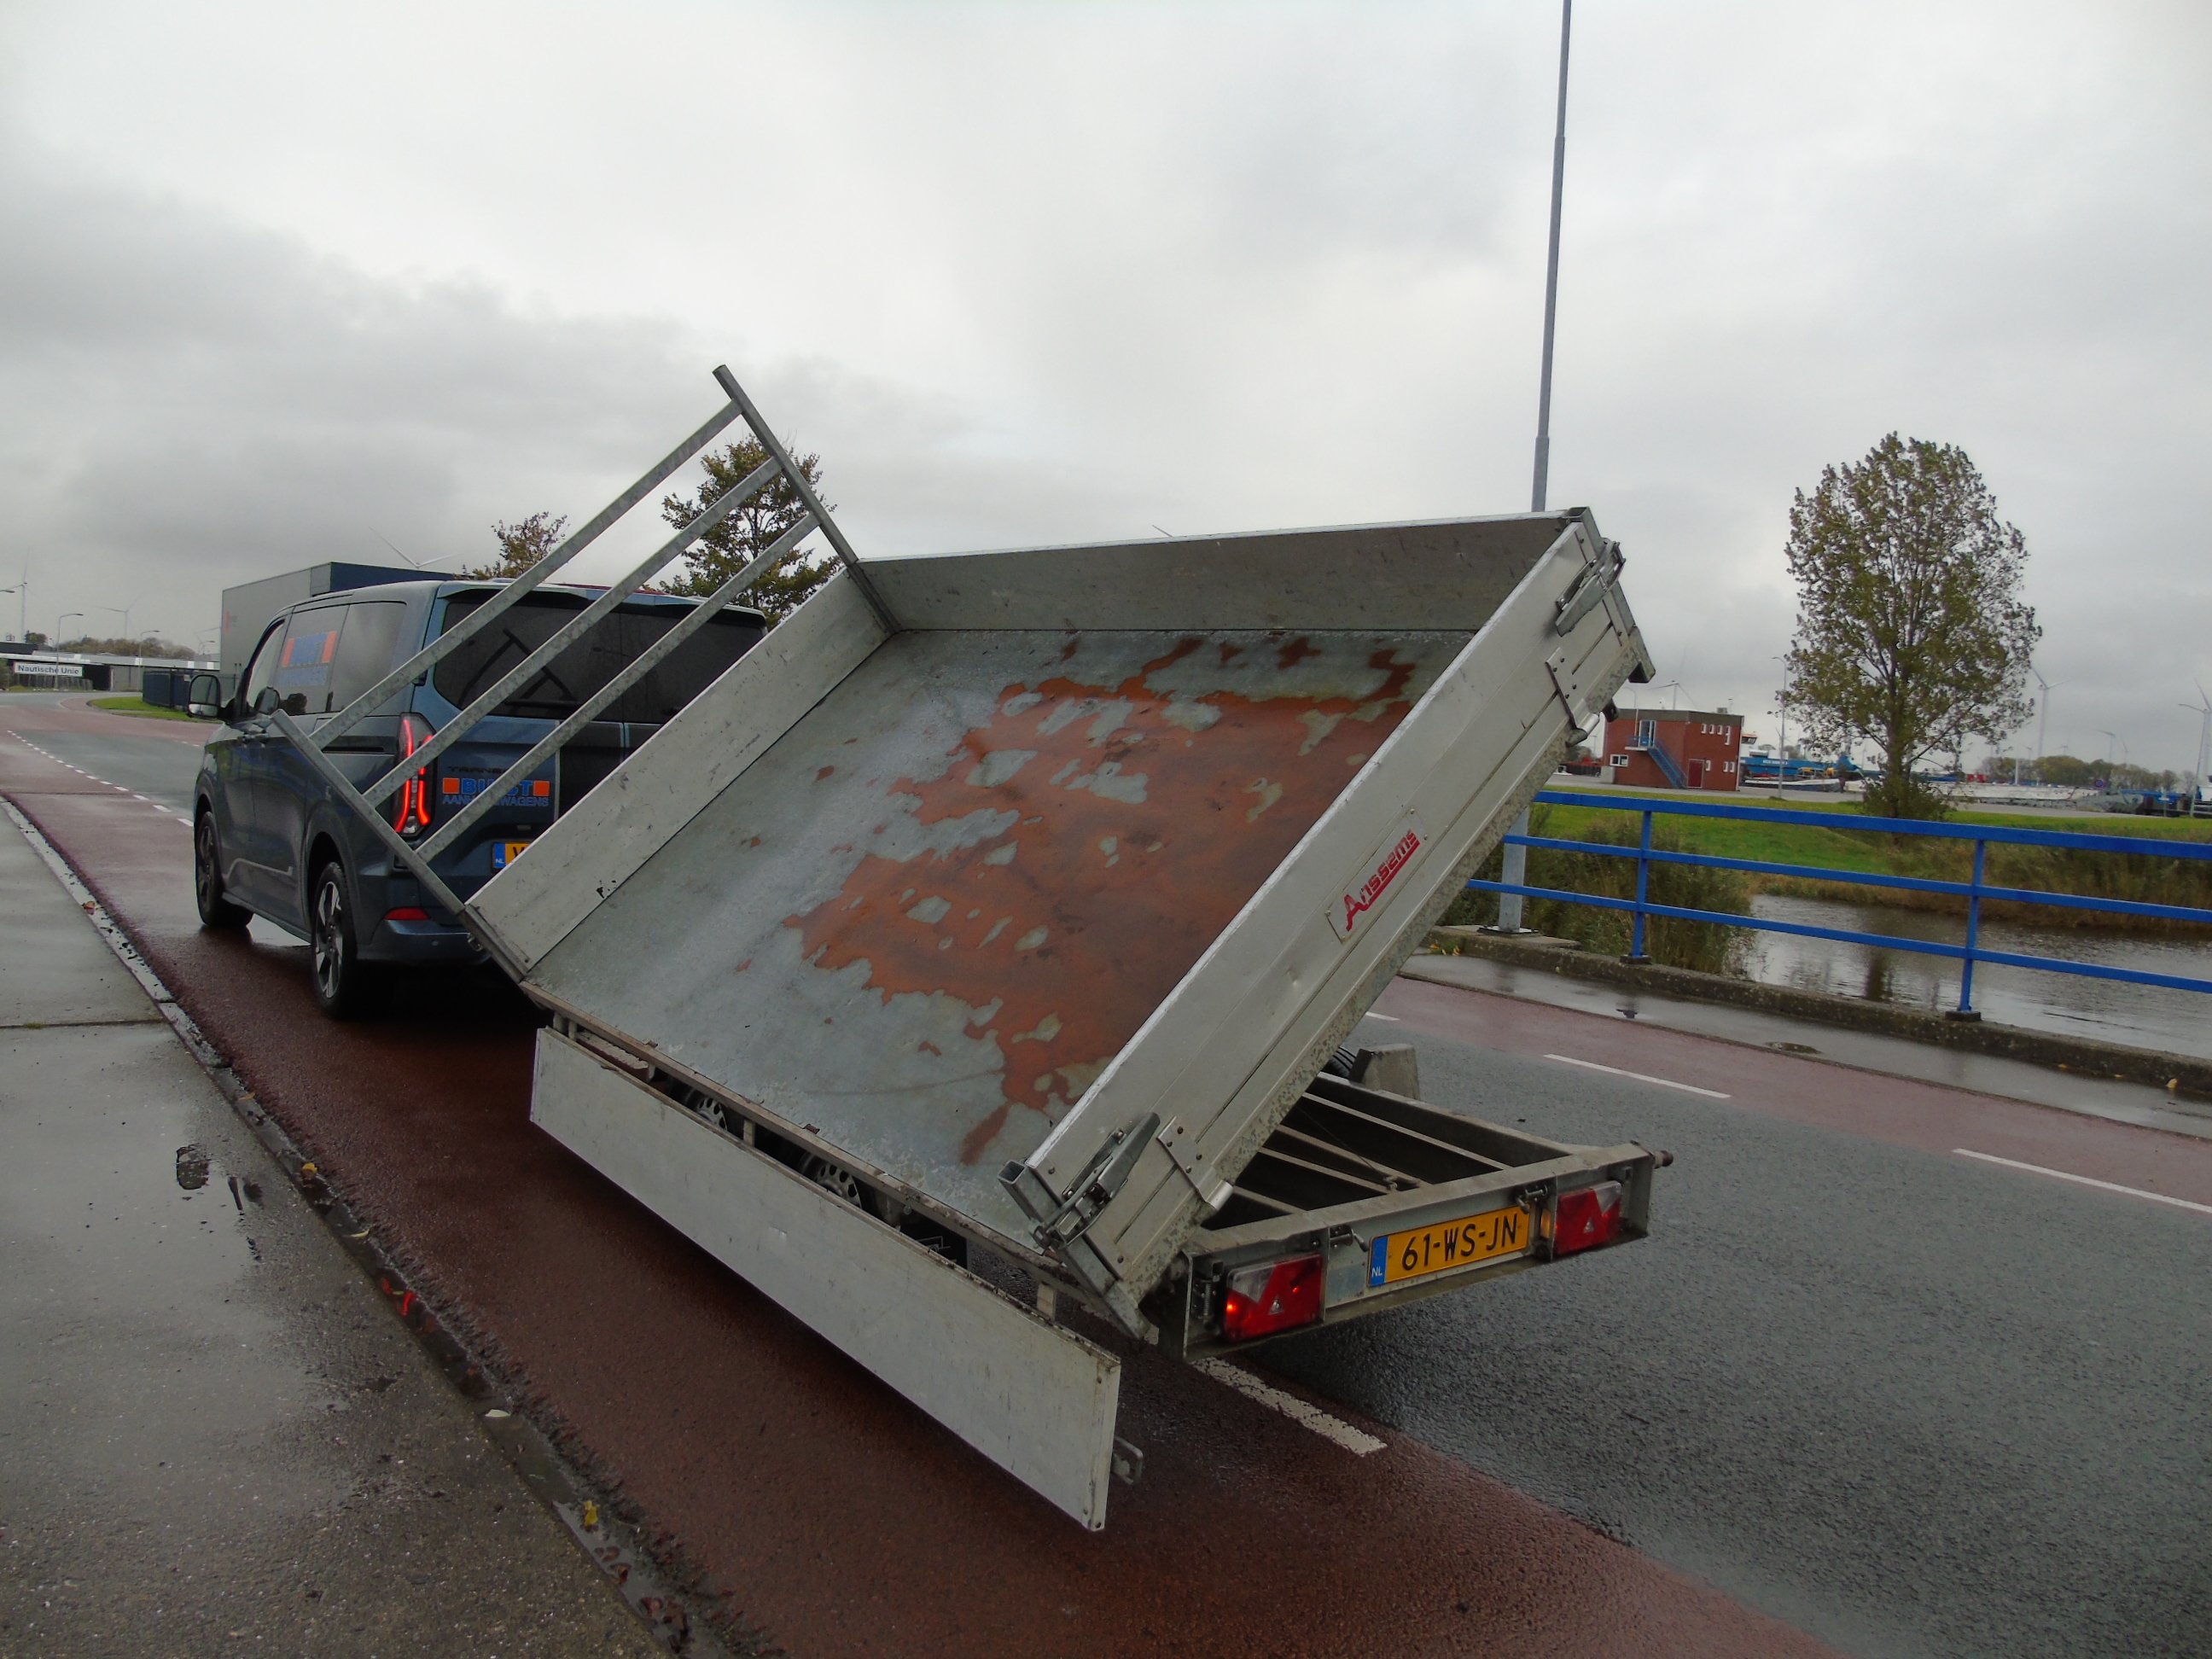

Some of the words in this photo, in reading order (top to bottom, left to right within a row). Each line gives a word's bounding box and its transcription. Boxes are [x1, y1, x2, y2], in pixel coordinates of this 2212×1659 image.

[18, 665, 59, 674] Nautische
[61, 666, 80, 675] Unie
[1343, 829, 1421, 932] Anssems
[1401, 1213, 1518, 1271] 61-WS-JN
[1371, 1267, 1383, 1278] NL
